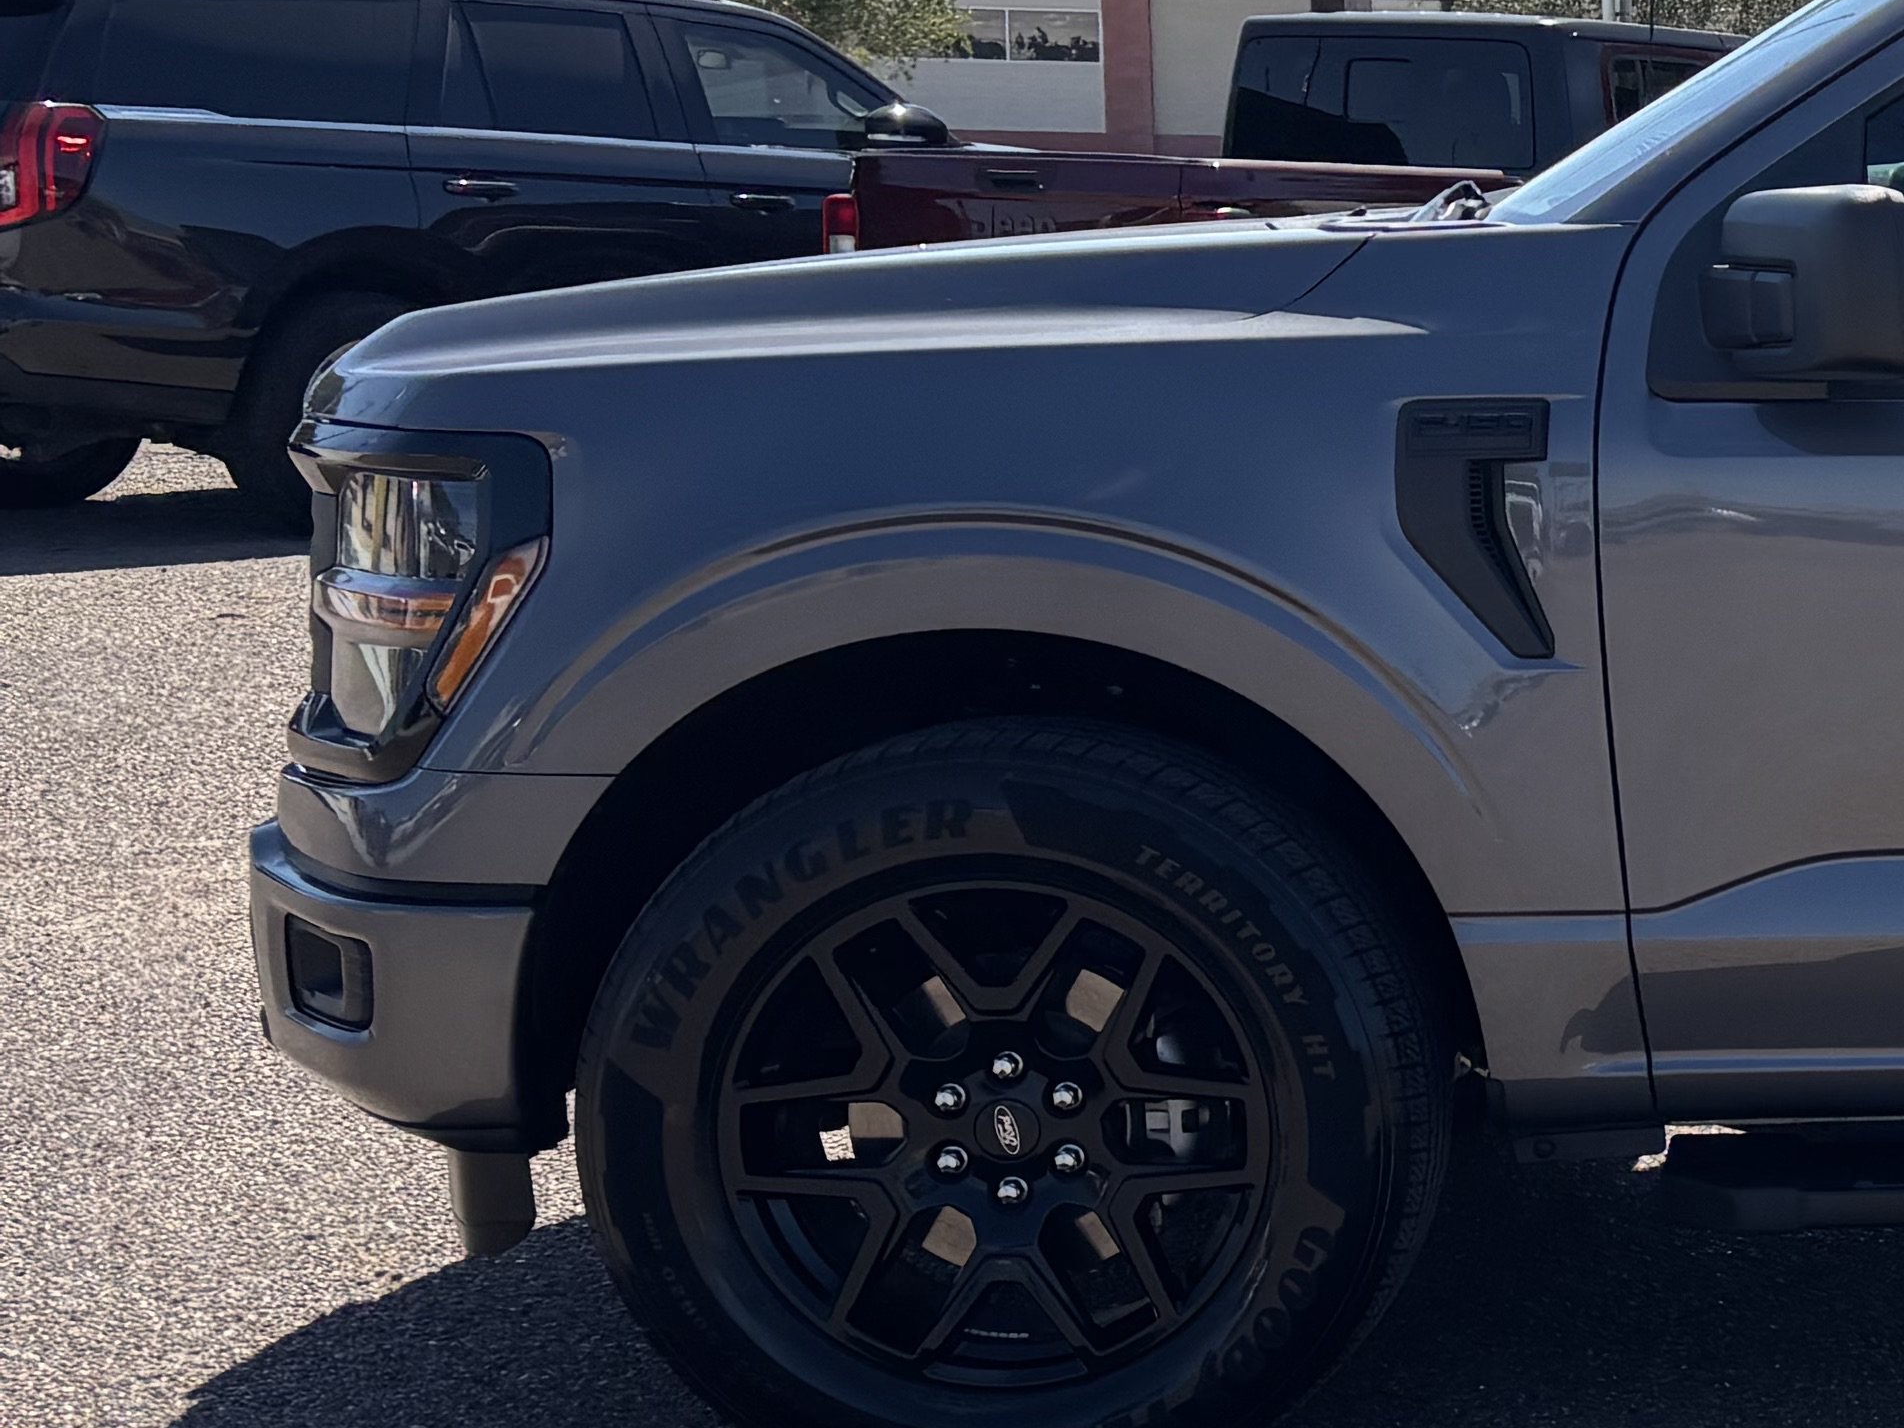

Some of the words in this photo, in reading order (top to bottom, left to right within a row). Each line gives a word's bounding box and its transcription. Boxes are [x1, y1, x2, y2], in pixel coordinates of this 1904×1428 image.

[628, 796, 973, 1053] WRANGLER
[1132, 843, 1310, 1010] TERRITORY
[1302, 1032, 1337, 1083] HT
